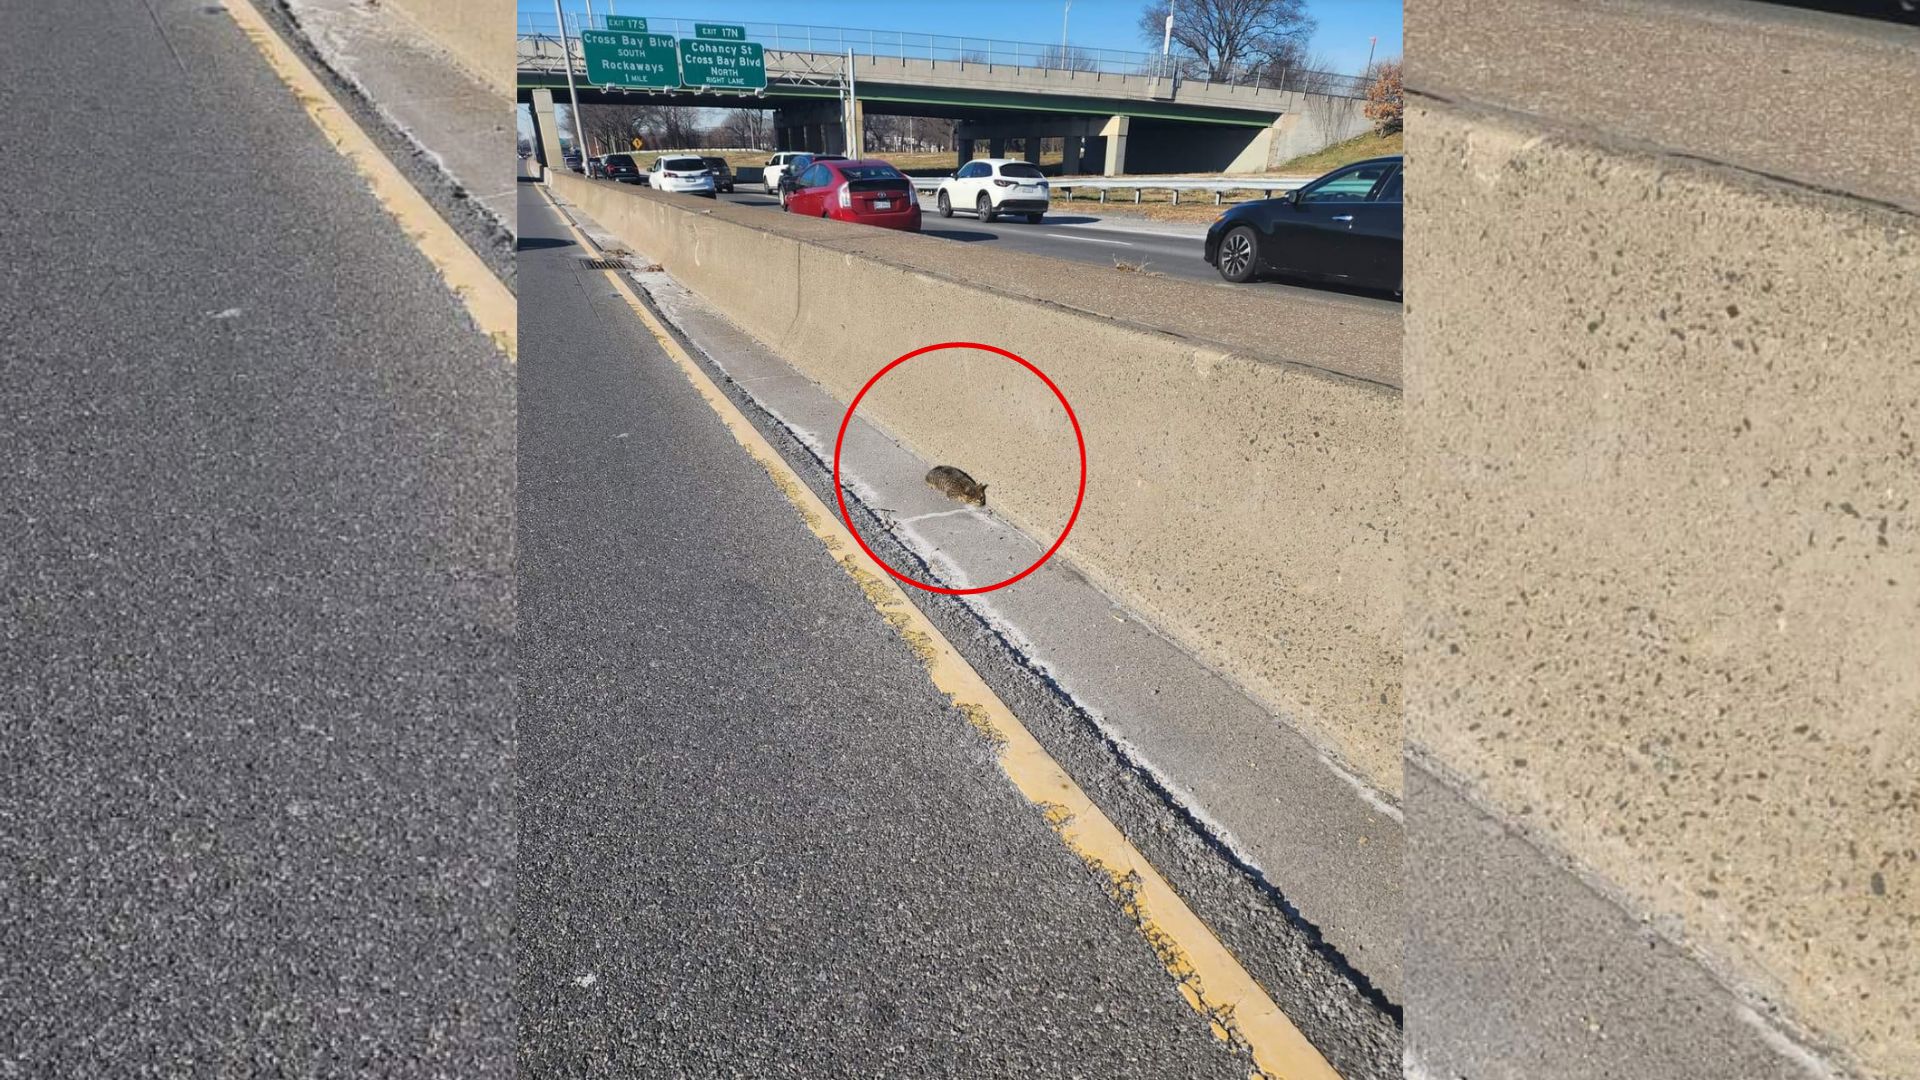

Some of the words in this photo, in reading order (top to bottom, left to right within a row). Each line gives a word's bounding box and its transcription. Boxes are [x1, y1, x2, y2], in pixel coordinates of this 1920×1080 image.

[628, 19, 645, 29] 17S
[722, 29, 738, 37] 17N
[585, 33, 616, 44] Cross
[622, 36, 643, 47] Bay
[650, 37, 674, 48] Blvd
[618, 49, 645, 57] SOUTH
[692, 43, 737, 55] Cohancy
[741, 46, 752, 54] St
[686, 55, 713, 64] Cross
[717, 56, 735, 67] Bay
[739, 58, 760, 67] Blvd
[602, 60, 664, 74] Rockaways
[711, 67, 738, 76] NORTH
[625, 74, 629, 82] 1
